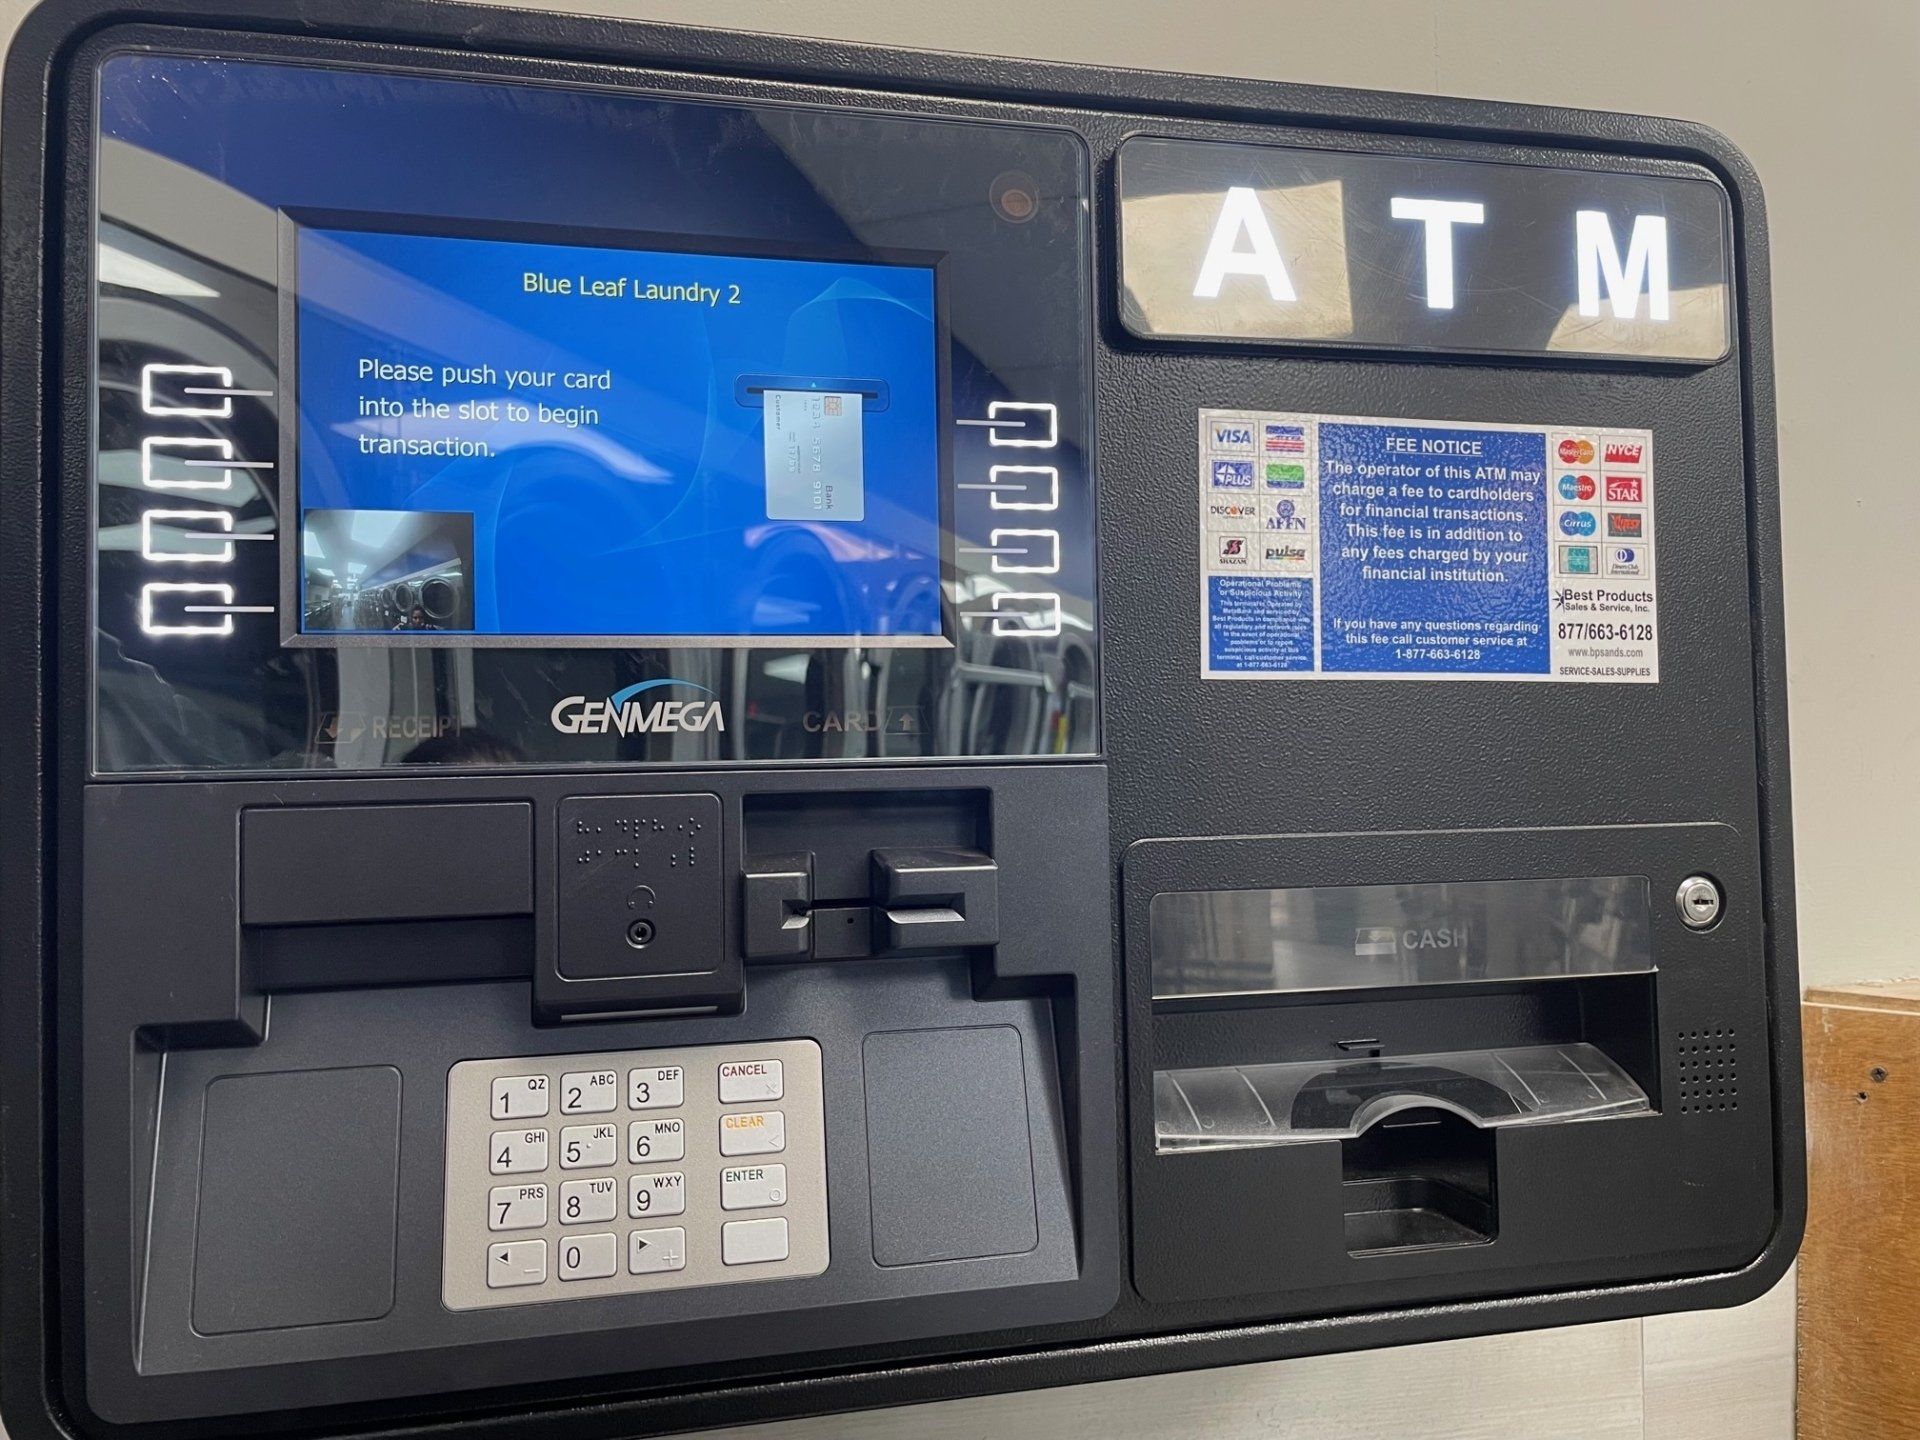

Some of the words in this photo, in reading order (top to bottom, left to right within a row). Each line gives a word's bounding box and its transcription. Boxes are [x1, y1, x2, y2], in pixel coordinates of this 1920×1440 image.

[523, 273, 572, 294] Blue
[580, 276, 627, 297] Leaf
[634, 279, 720, 306] Laundry
[728, 285, 741, 304] 2
[359, 359, 434, 382] Please
[442, 364, 496, 387] push
[505, 369, 556, 389] your
[564, 370, 611, 390] card
[359, 397, 403, 418] into
[412, 398, 450, 419] the
[458, 399, 498, 421] slot
[506, 402, 530, 423] to
[538, 403, 598, 428] begin
[1216, 429, 1251, 444] VISA
[359, 434, 495, 457] transaction.
[1386, 438, 1417, 452] FEE
[1422, 439, 1482, 455] NOTICE
[1607, 444, 1640, 456] NYCE
[1225, 475, 1251, 485] PLUS
[1326, 461, 1353, 474] The
[1358, 465, 1421, 477] operator
[1425, 465, 1440, 478] of
[1444, 466, 1471, 479] this
[1475, 468, 1506, 480] ATM
[1511, 471, 1540, 485] may
[813, 481, 822, 510] 9101
[1333, 483, 1384, 499] charge
[1389, 487, 1397, 497] a
[1402, 484, 1424, 497] fee
[1428, 486, 1443, 498] to
[1448, 486, 1534, 502] cardholders
[1608, 489, 1640, 500] STAR
[1210, 505, 1255, 516] DISCOVER
[1340, 503, 1361, 516] for
[1366, 504, 1429, 519] financial
[1433, 507, 1527, 522] transactions.
[1266, 517, 1306, 530] AFFN
[1564, 520, 1592, 528] Cirrus
[1346, 524, 1378, 538] This
[1382, 524, 1405, 538] fee
[1410, 525, 1422, 539] is
[1427, 526, 1440, 539] in
[1445, 526, 1504, 541] addition
[1508, 529, 1523, 542] to
[1265, 545, 1305, 559] pulse
[1342, 548, 1369, 562] any
[1373, 546, 1404, 559] fees
[1409, 548, 1469, 564] charged
[1473, 548, 1491, 564] by
[1495, 550, 1528, 564] your
[1362, 566, 1426, 581] financial
[1430, 567, 1509, 582] institution.
[1220, 579, 1264, 588] Operational
[1564, 589, 1593, 600] Best
[1597, 590, 1653, 602] Products
[1565, 603, 1588, 611] Sales
[1600, 604, 1633, 613] Service,
[1333, 618, 1343, 629] If
[1344, 620, 1367, 631] you
[1369, 618, 1398, 629] have
[1400, 620, 1422, 632] any
[1425, 620, 1481, 633] questions
[1484, 621, 1539, 634] regarding
[1558, 623, 1652, 640] 877/663-6128
[1346, 633, 1368, 643] this
[1371, 634, 1389, 644] fee
[1392, 634, 1413, 644] call
[1415, 635, 1470, 645] customer
[1473, 635, 1514, 646] service
[1517, 636, 1528, 646] at
[1395, 649, 1481, 660] 1-877-663-6128
[1568, 647, 1643, 659] www.bpsands.com
[551, 696, 725, 738] GENMEGA
[803, 711, 882, 732] CARD
[1403, 928, 1468, 949] CASH
[657, 1069, 679, 1081] DEF
[722, 1065, 767, 1077] CANCEL
[528, 1079, 545, 1091] QZ
[590, 1074, 614, 1086] ABC
[567, 1088, 582, 1109] 2
[636, 1083, 650, 1103] 3
[500, 1092, 510, 1114] 1
[655, 1122, 680, 1134] MNO
[725, 1116, 764, 1128] CLEAR
[525, 1132, 545, 1143] GHI
[593, 1127, 614, 1139] JKL
[566, 1141, 580, 1163] 5
[636, 1136, 651, 1157] 6
[496, 1147, 512, 1167] 4
[653, 1176, 681, 1188] WXY
[726, 1169, 764, 1182] ENTER
[519, 1188, 544, 1200] PRS
[589, 1182, 613, 1193] TUV
[566, 1196, 580, 1218] 8
[637, 1190, 651, 1211] 9
[497, 1202, 512, 1224] 7
[566, 1247, 581, 1268] 0
